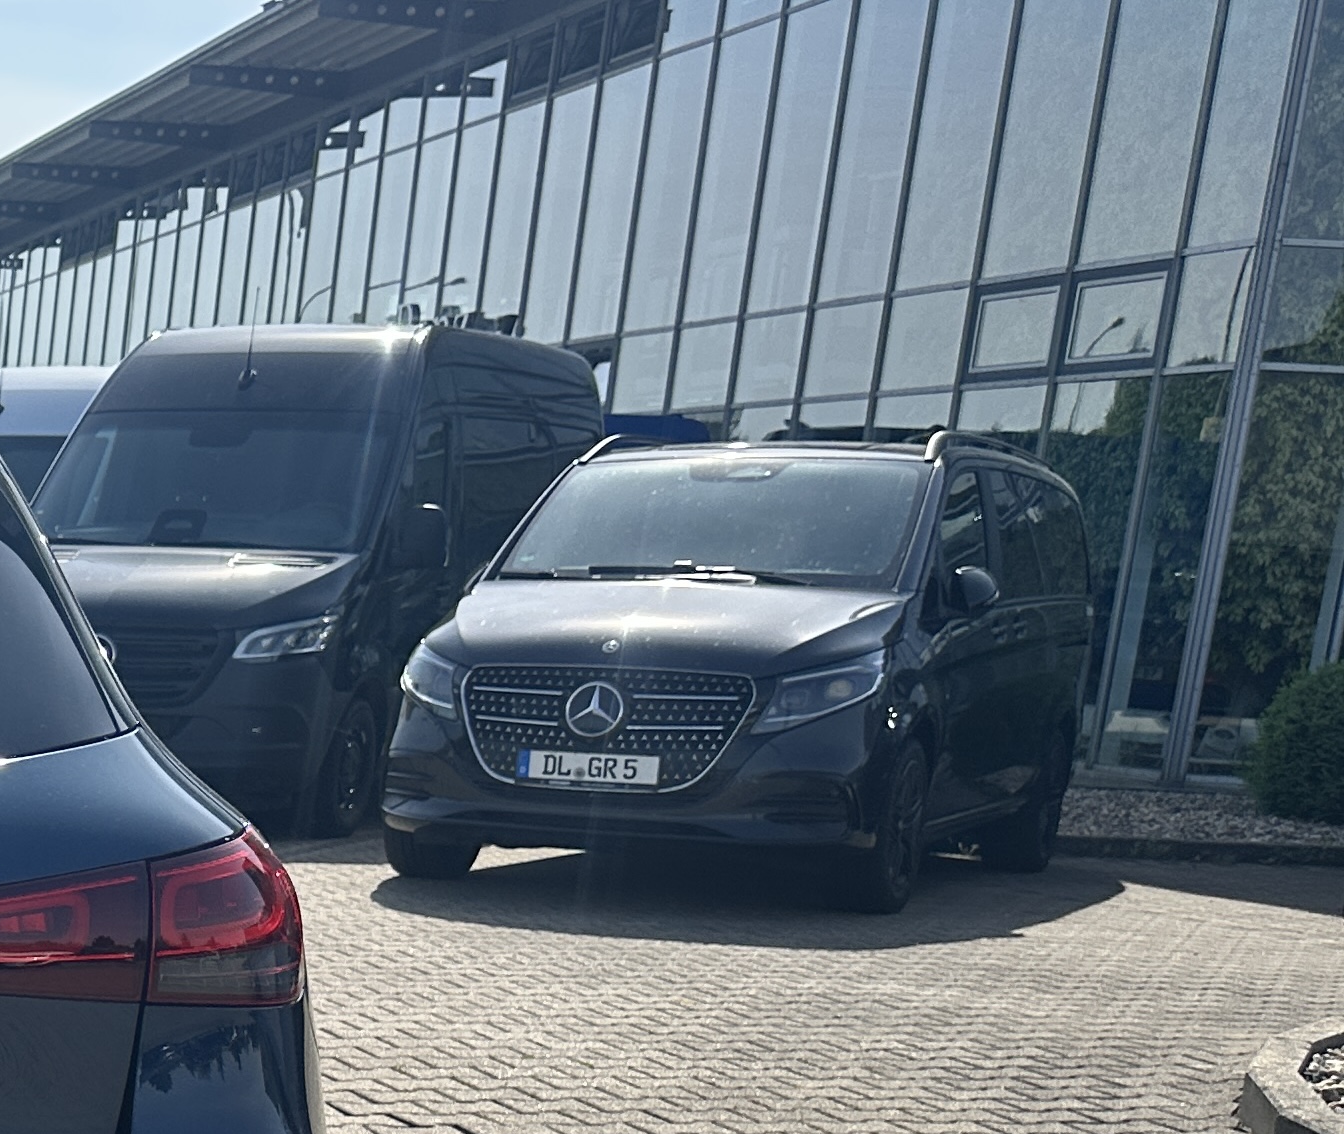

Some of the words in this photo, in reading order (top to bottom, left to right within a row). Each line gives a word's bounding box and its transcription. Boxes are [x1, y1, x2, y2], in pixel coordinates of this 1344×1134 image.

[542, 754, 571, 776] DL
[588, 756, 617, 779] GR
[622, 759, 639, 780] 5
